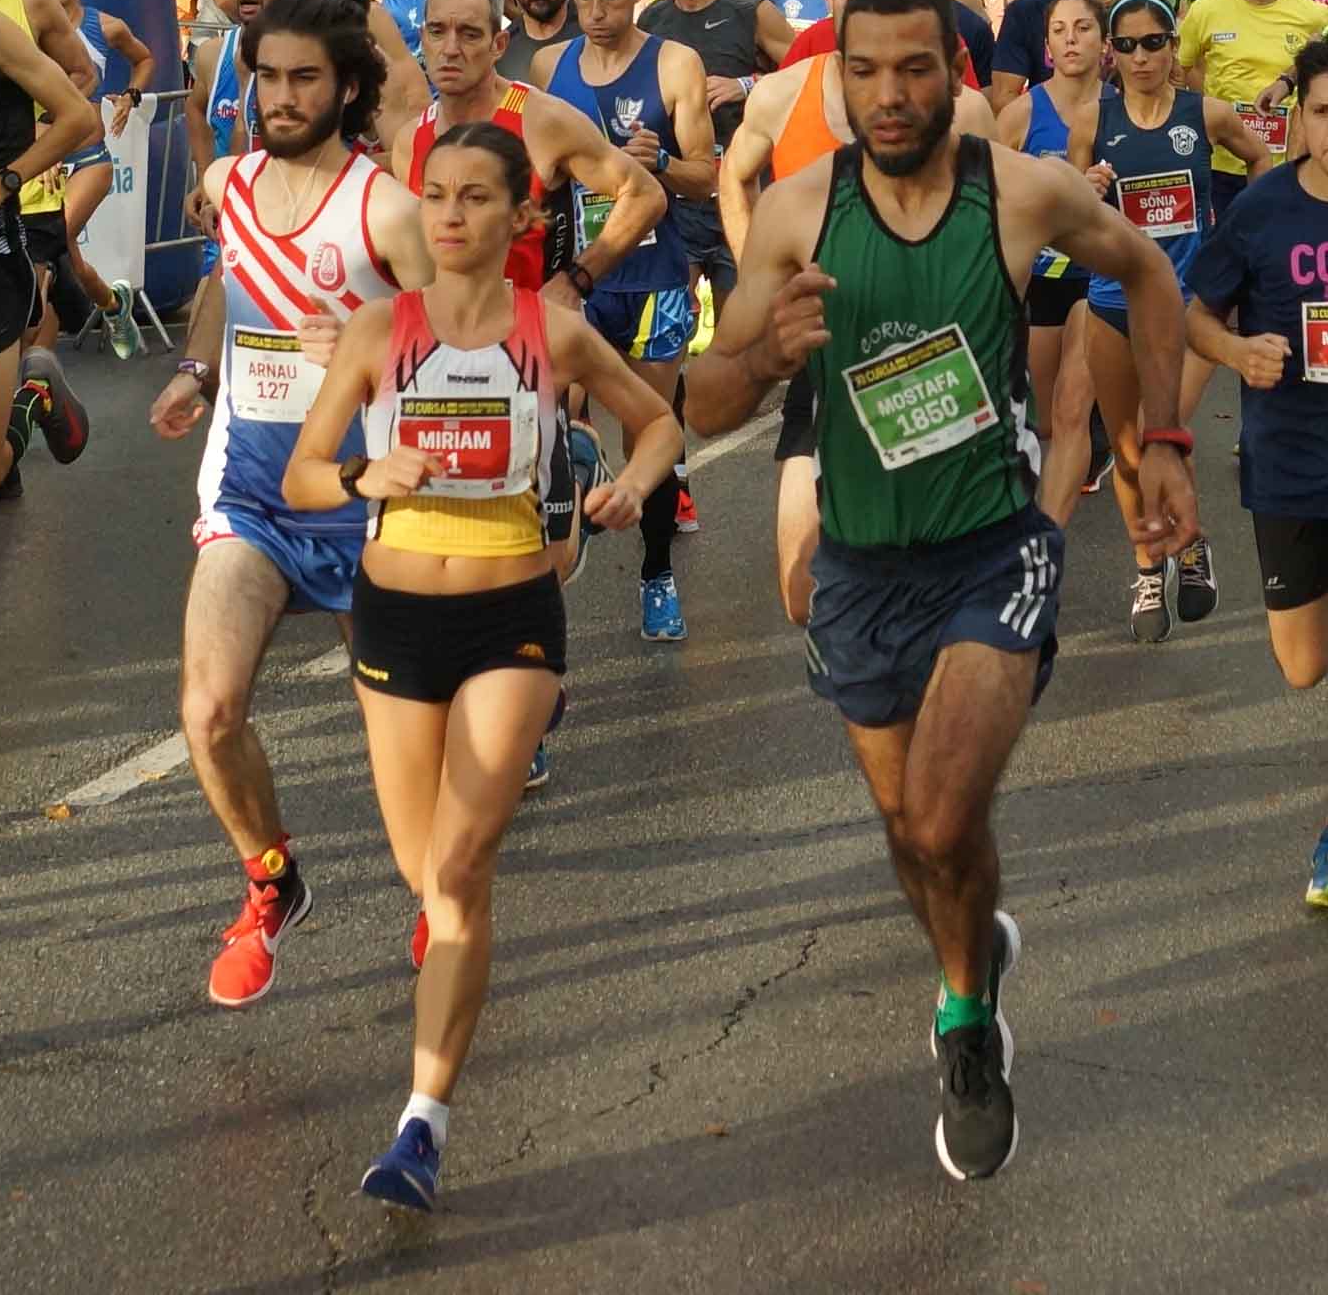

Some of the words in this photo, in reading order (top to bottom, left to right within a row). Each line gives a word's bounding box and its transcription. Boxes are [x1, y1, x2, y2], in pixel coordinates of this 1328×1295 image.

[1242, 119, 1279, 131] CARLOS
[1146, 208, 1174, 223] 608
[248, 362, 297, 380] ARNAU
[256, 381, 290, 401] 127
[877, 369, 960, 418] MOSTAFA
[896, 394, 960, 437] 1850
[417, 430, 492, 450] MIRIAM
[446, 451, 462, 474] 1
